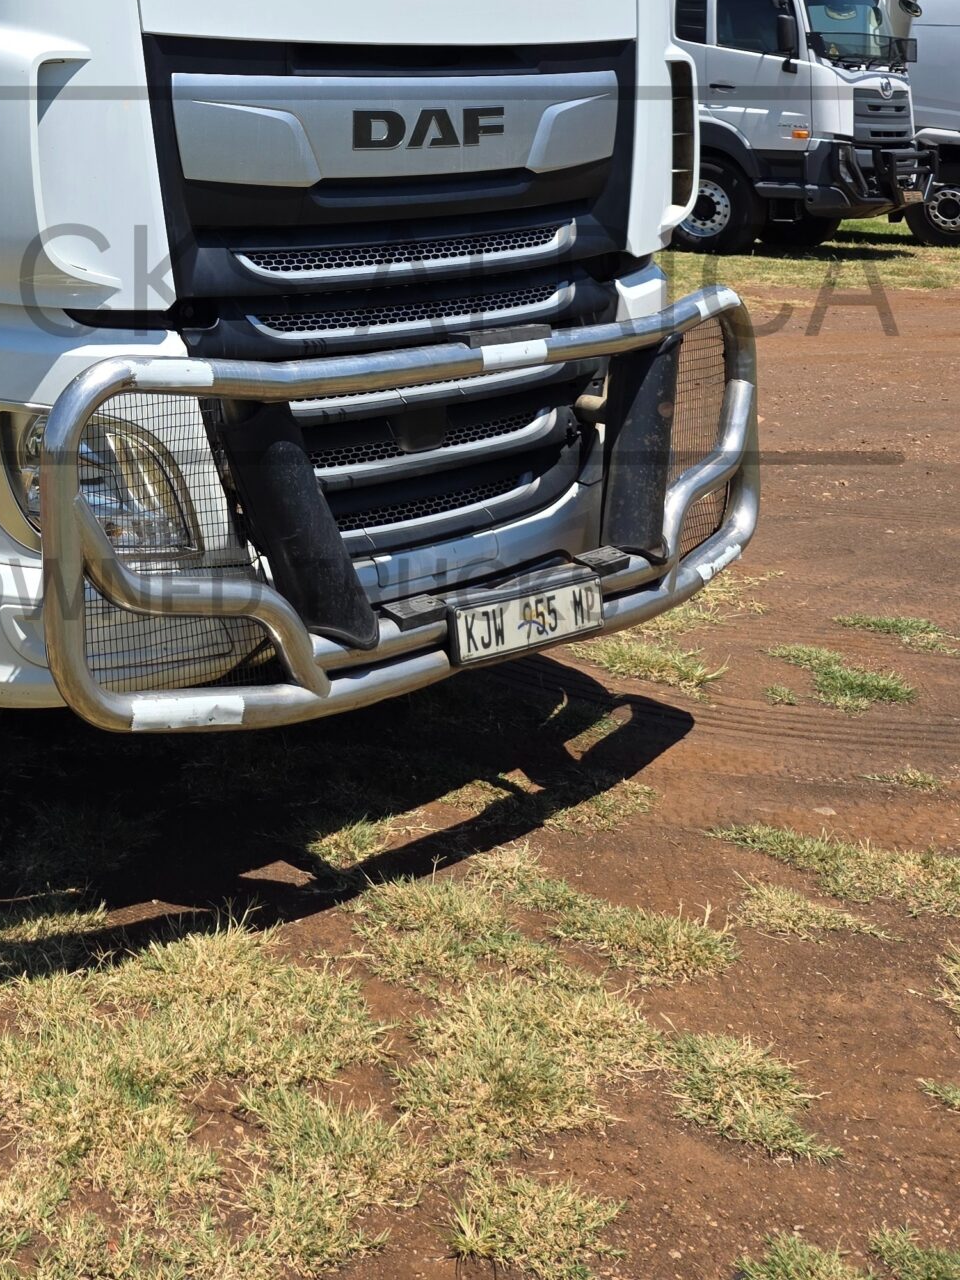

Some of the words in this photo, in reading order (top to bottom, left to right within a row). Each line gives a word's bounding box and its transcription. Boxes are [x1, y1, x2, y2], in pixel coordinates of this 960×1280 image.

[352, 107, 505, 151] DAF
[464, 607, 505, 653] KJW
[523, 595, 558, 640] 955
[572, 587, 595, 627] MP
